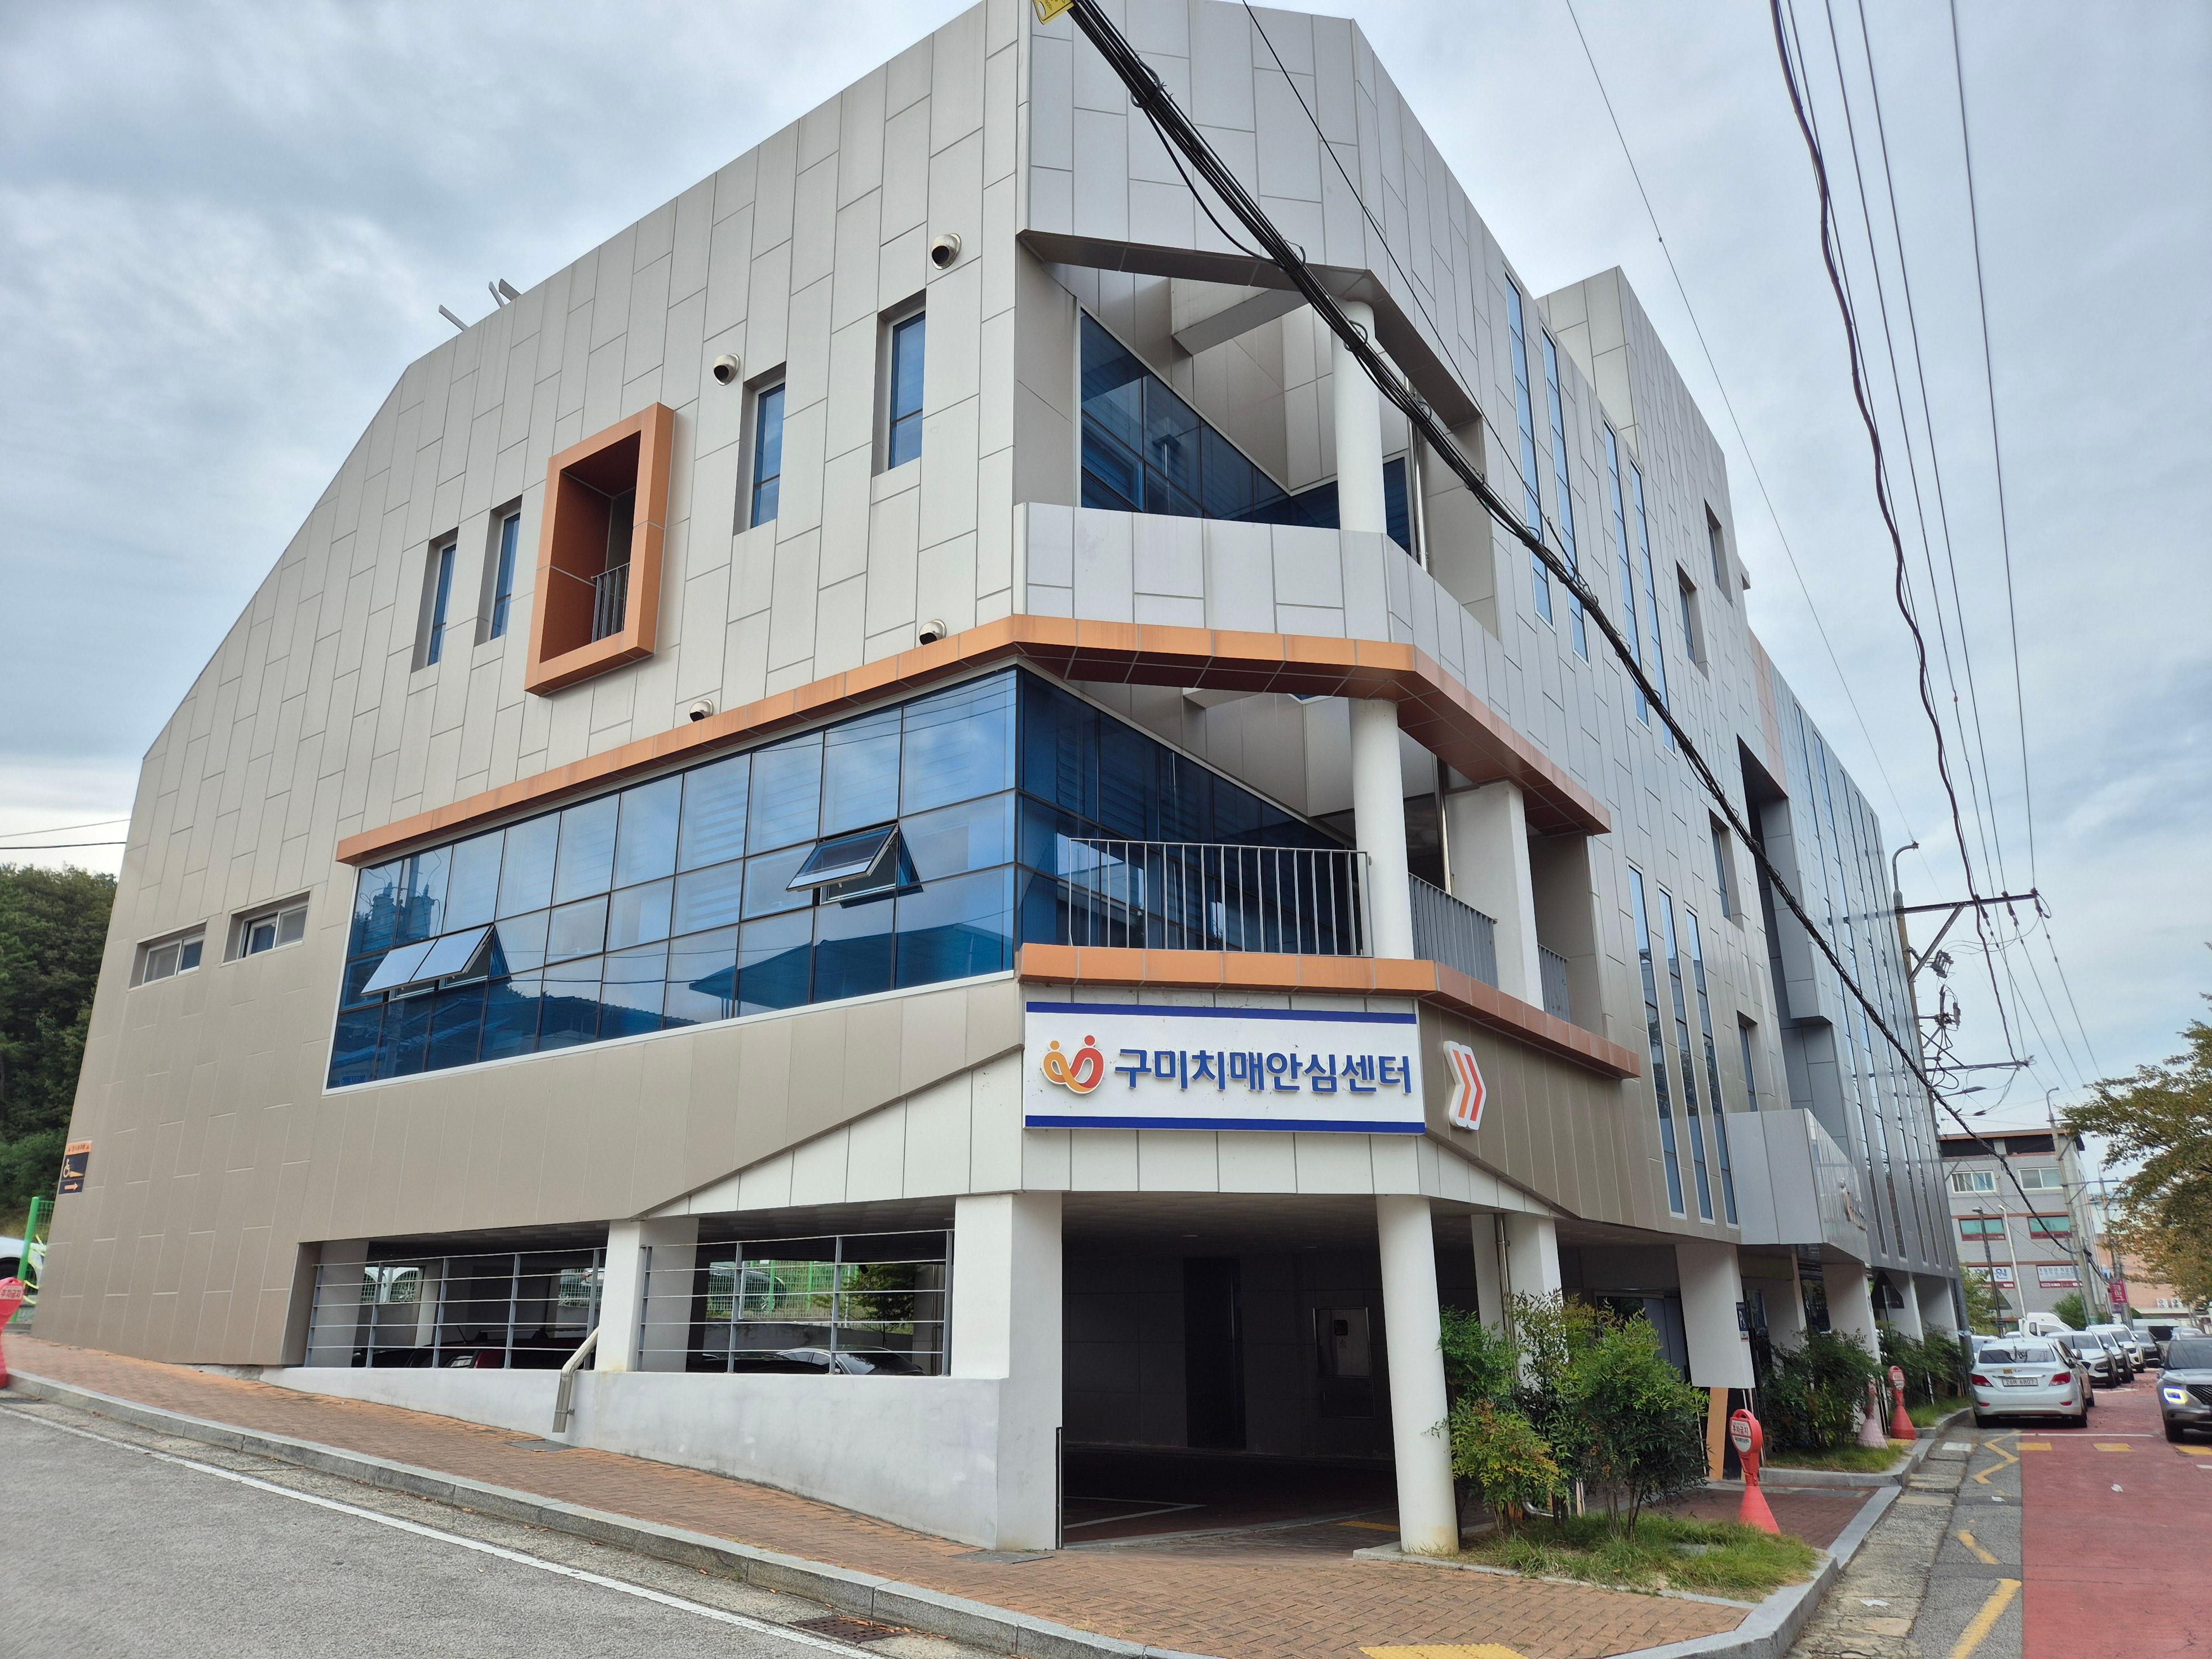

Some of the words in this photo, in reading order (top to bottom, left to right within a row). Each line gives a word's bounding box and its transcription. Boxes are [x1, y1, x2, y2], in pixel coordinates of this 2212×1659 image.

[1114, 1048, 1412, 1095] 구미치매안심센터
[1, 1289, 21, 1298] 주차금지
[1739, 1311, 1743, 1328] P
[1733, 1425, 1749, 1435] 주차금지
